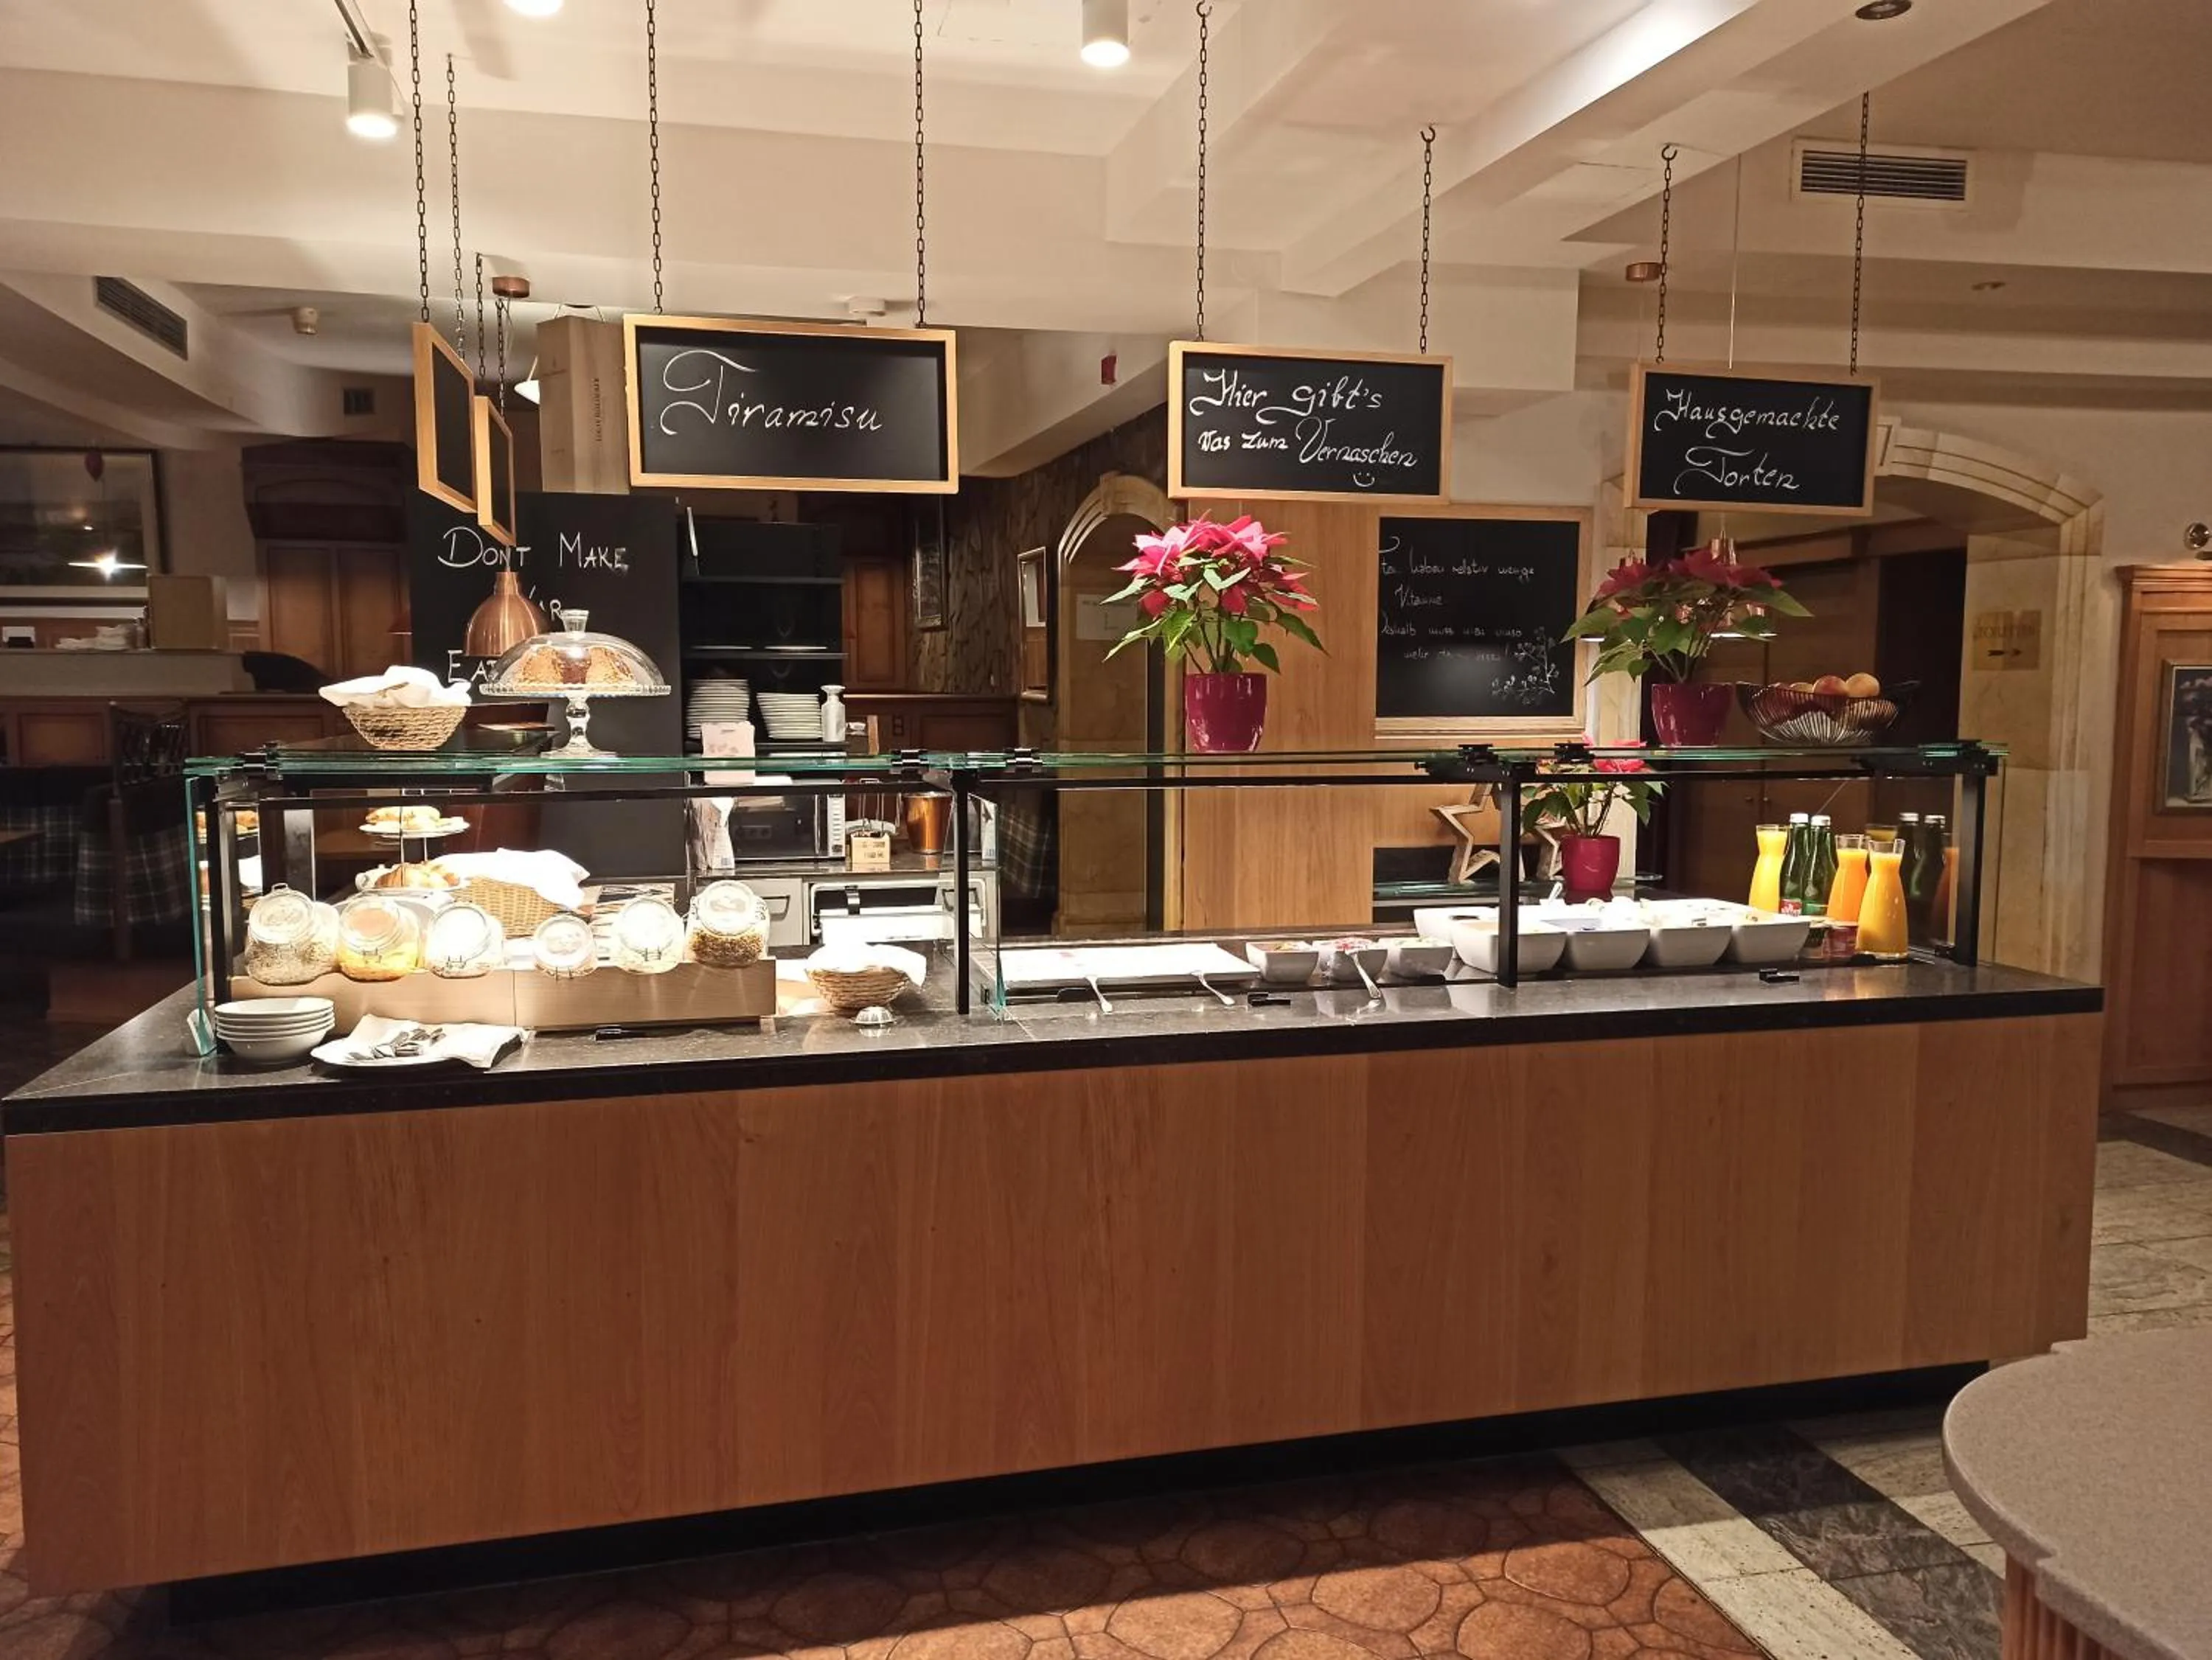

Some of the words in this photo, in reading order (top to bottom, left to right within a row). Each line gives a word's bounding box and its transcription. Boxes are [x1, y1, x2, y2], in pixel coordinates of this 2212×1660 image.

[660, 349, 882, 435] Tiramisu
[1189, 369, 1268, 416] Hier
[1653, 388, 1840, 439] Hausgemachte
[1673, 446, 1799, 495] Torten
